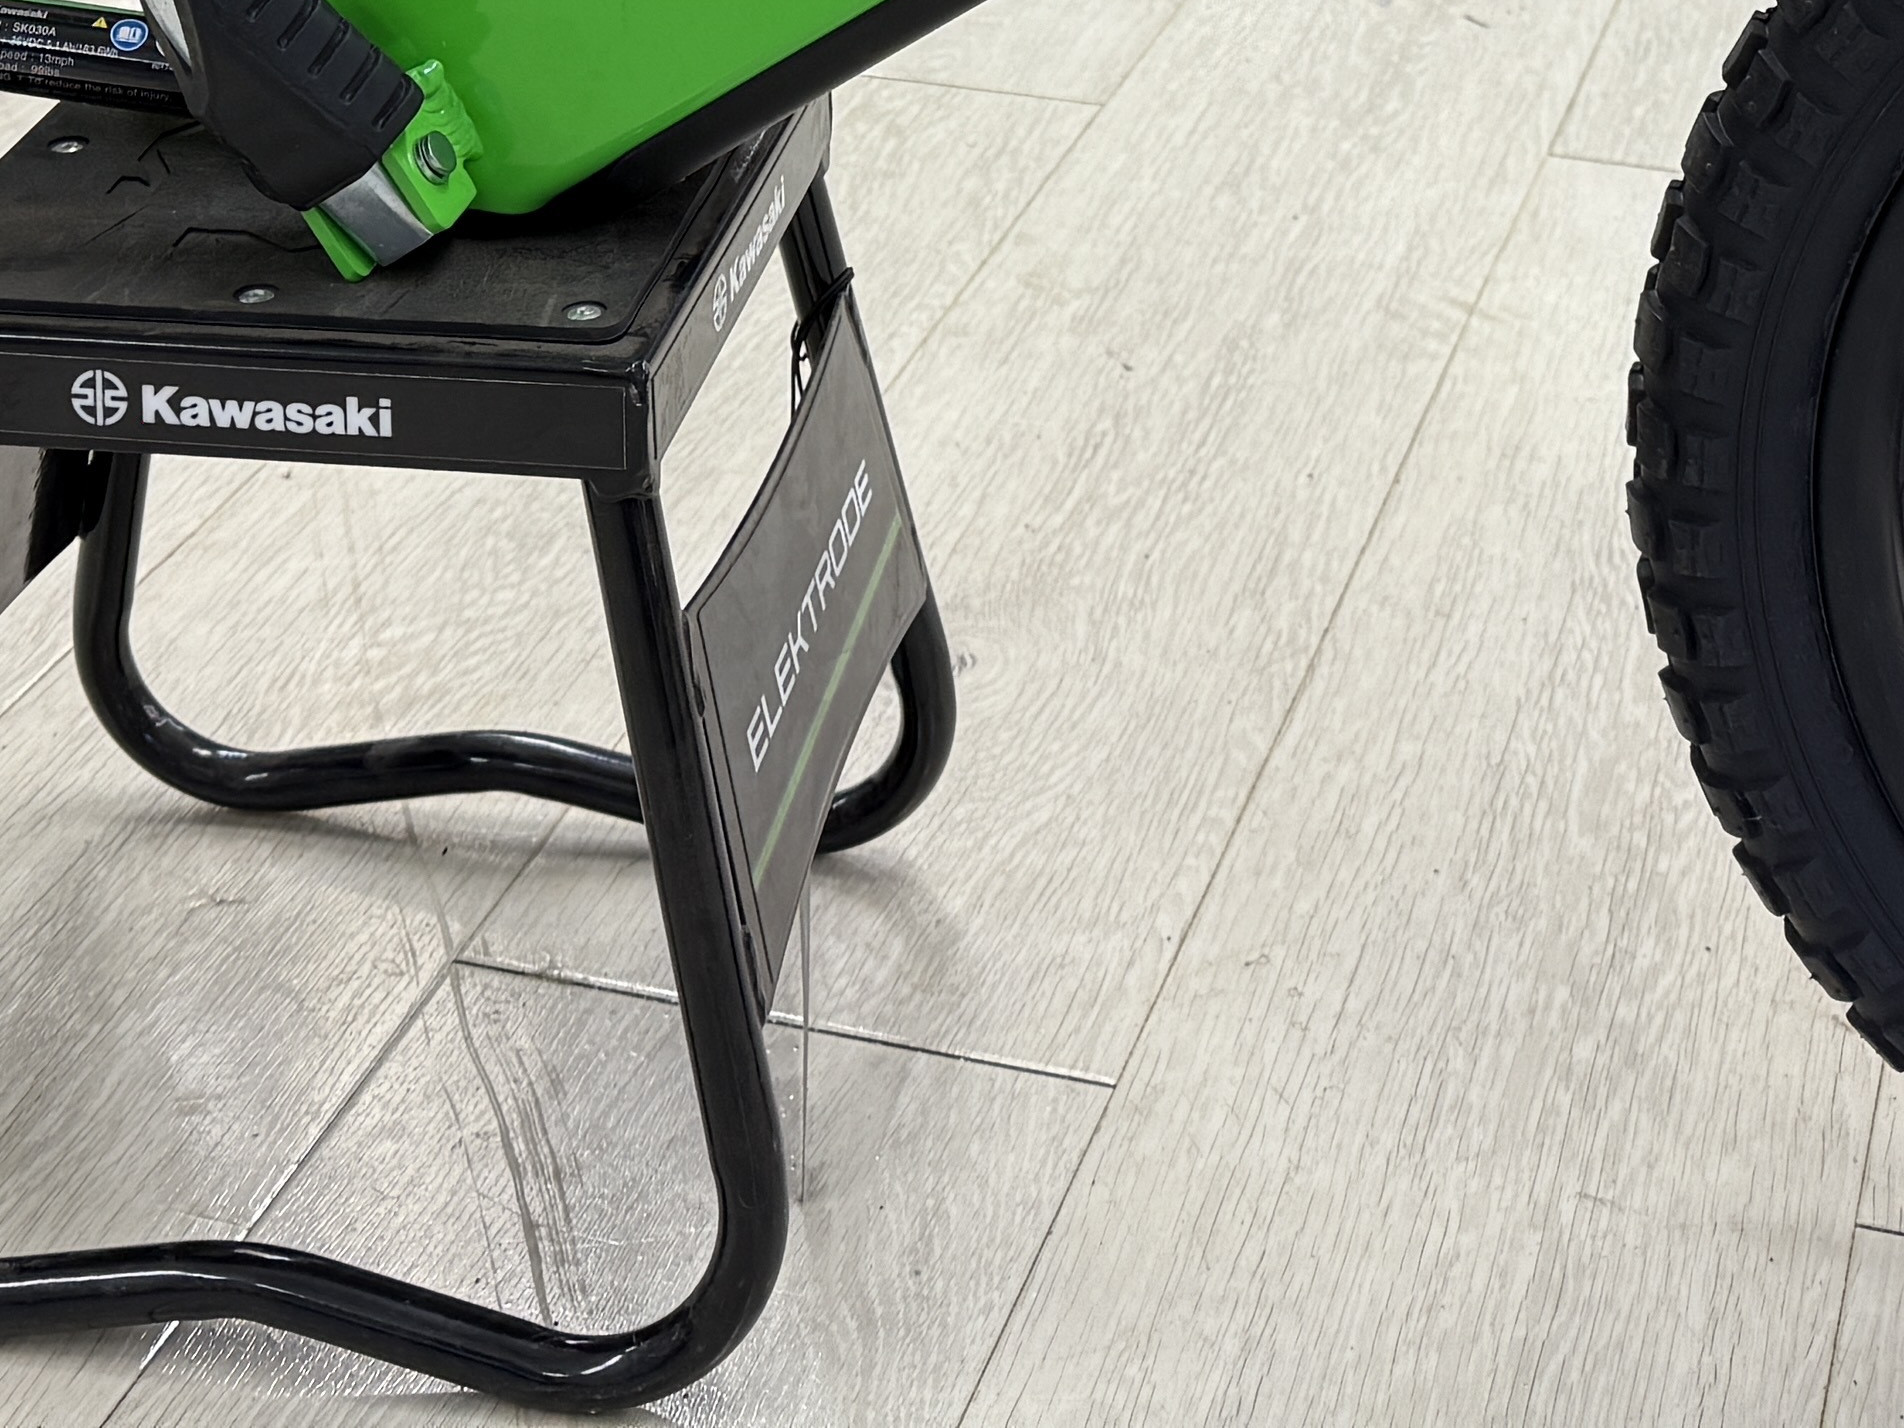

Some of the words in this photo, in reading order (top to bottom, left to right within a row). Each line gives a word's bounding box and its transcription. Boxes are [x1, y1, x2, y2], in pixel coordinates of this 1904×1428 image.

[12, 22, 56, 36] SK030A
[39, 53, 74, 67] 13mph
[45, 79, 81, 89] reduce
[85, 83, 101, 92] the
[105, 86, 123, 95] risk
[730, 174, 786, 303] Kawasaki
[141, 384, 393, 438] Kawasaki
[744, 459, 874, 773] ELEKTRODE
